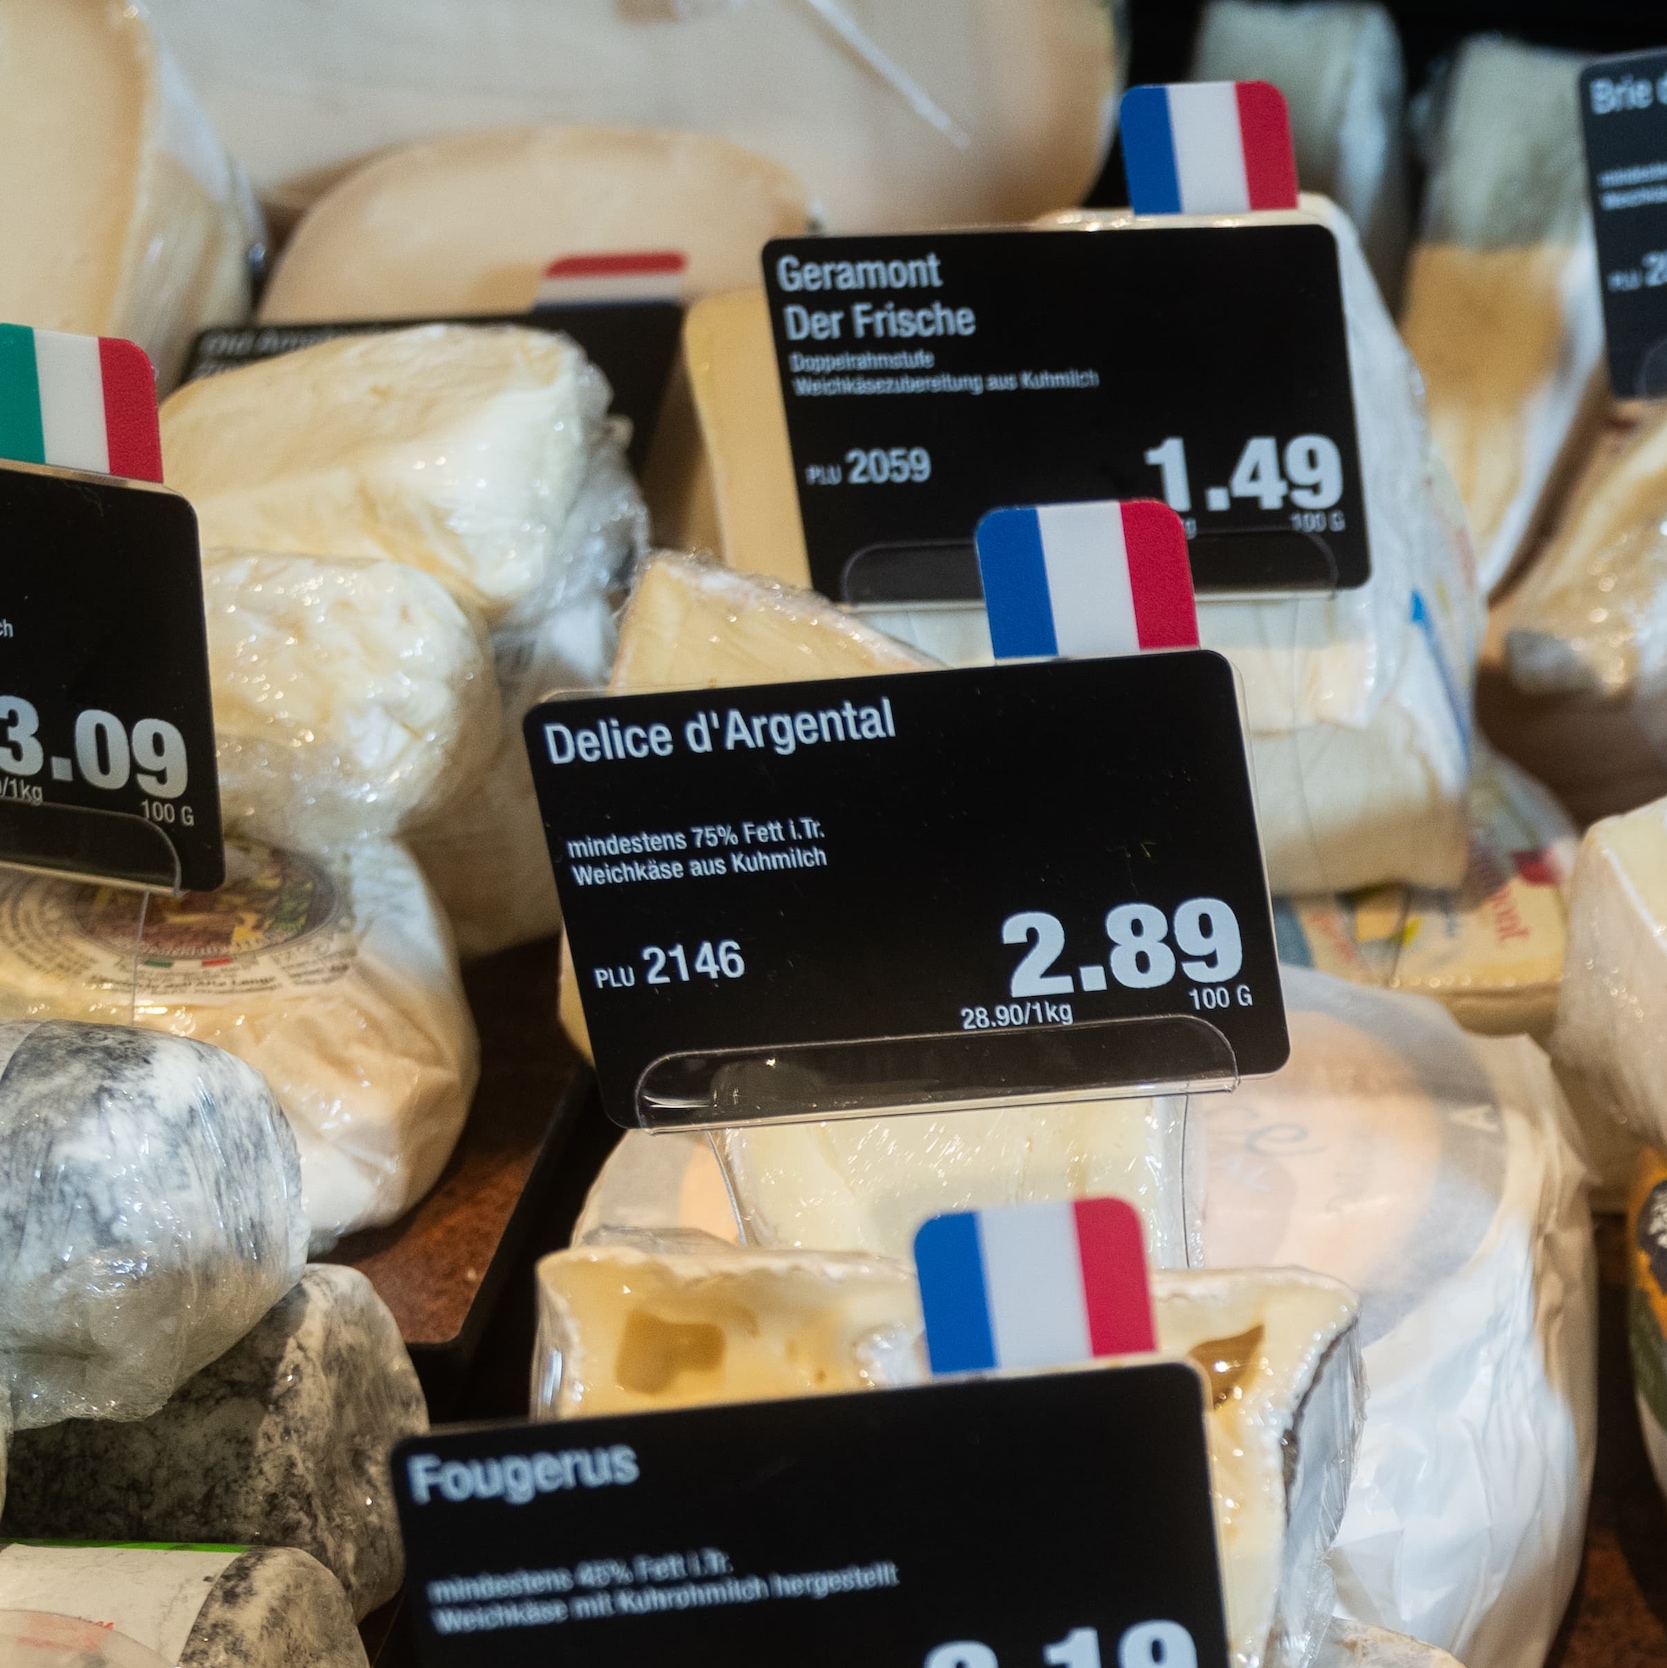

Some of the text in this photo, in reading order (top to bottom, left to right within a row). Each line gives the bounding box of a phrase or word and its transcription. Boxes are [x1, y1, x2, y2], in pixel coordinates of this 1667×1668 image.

[777, 253, 943, 292] Geramont
[784, 301, 976, 341] Der Frische
[806, 447, 931, 485] PLU 2059
[1144, 434, 1345, 513] 1.49
[1290, 511, 1346, 533] 100 G
[0, 695, 188, 799] 3.09
[543, 696, 896, 765] Delice d'Argental
[142, 799, 195, 826] 100 G
[566, 819, 825, 859] mindestens 75% Fett i.Tr.
[571, 846, 828, 886] Weichkäse aus Kuhmilch
[594, 939, 745, 989] PLU 2146
[1001, 897, 1243, 998] 2.89
[959, 1001, 1074, 1034] 28.90/1kg
[1189, 985, 1253, 1010] 100 G
[407, 1445, 640, 1504] Fougerus
